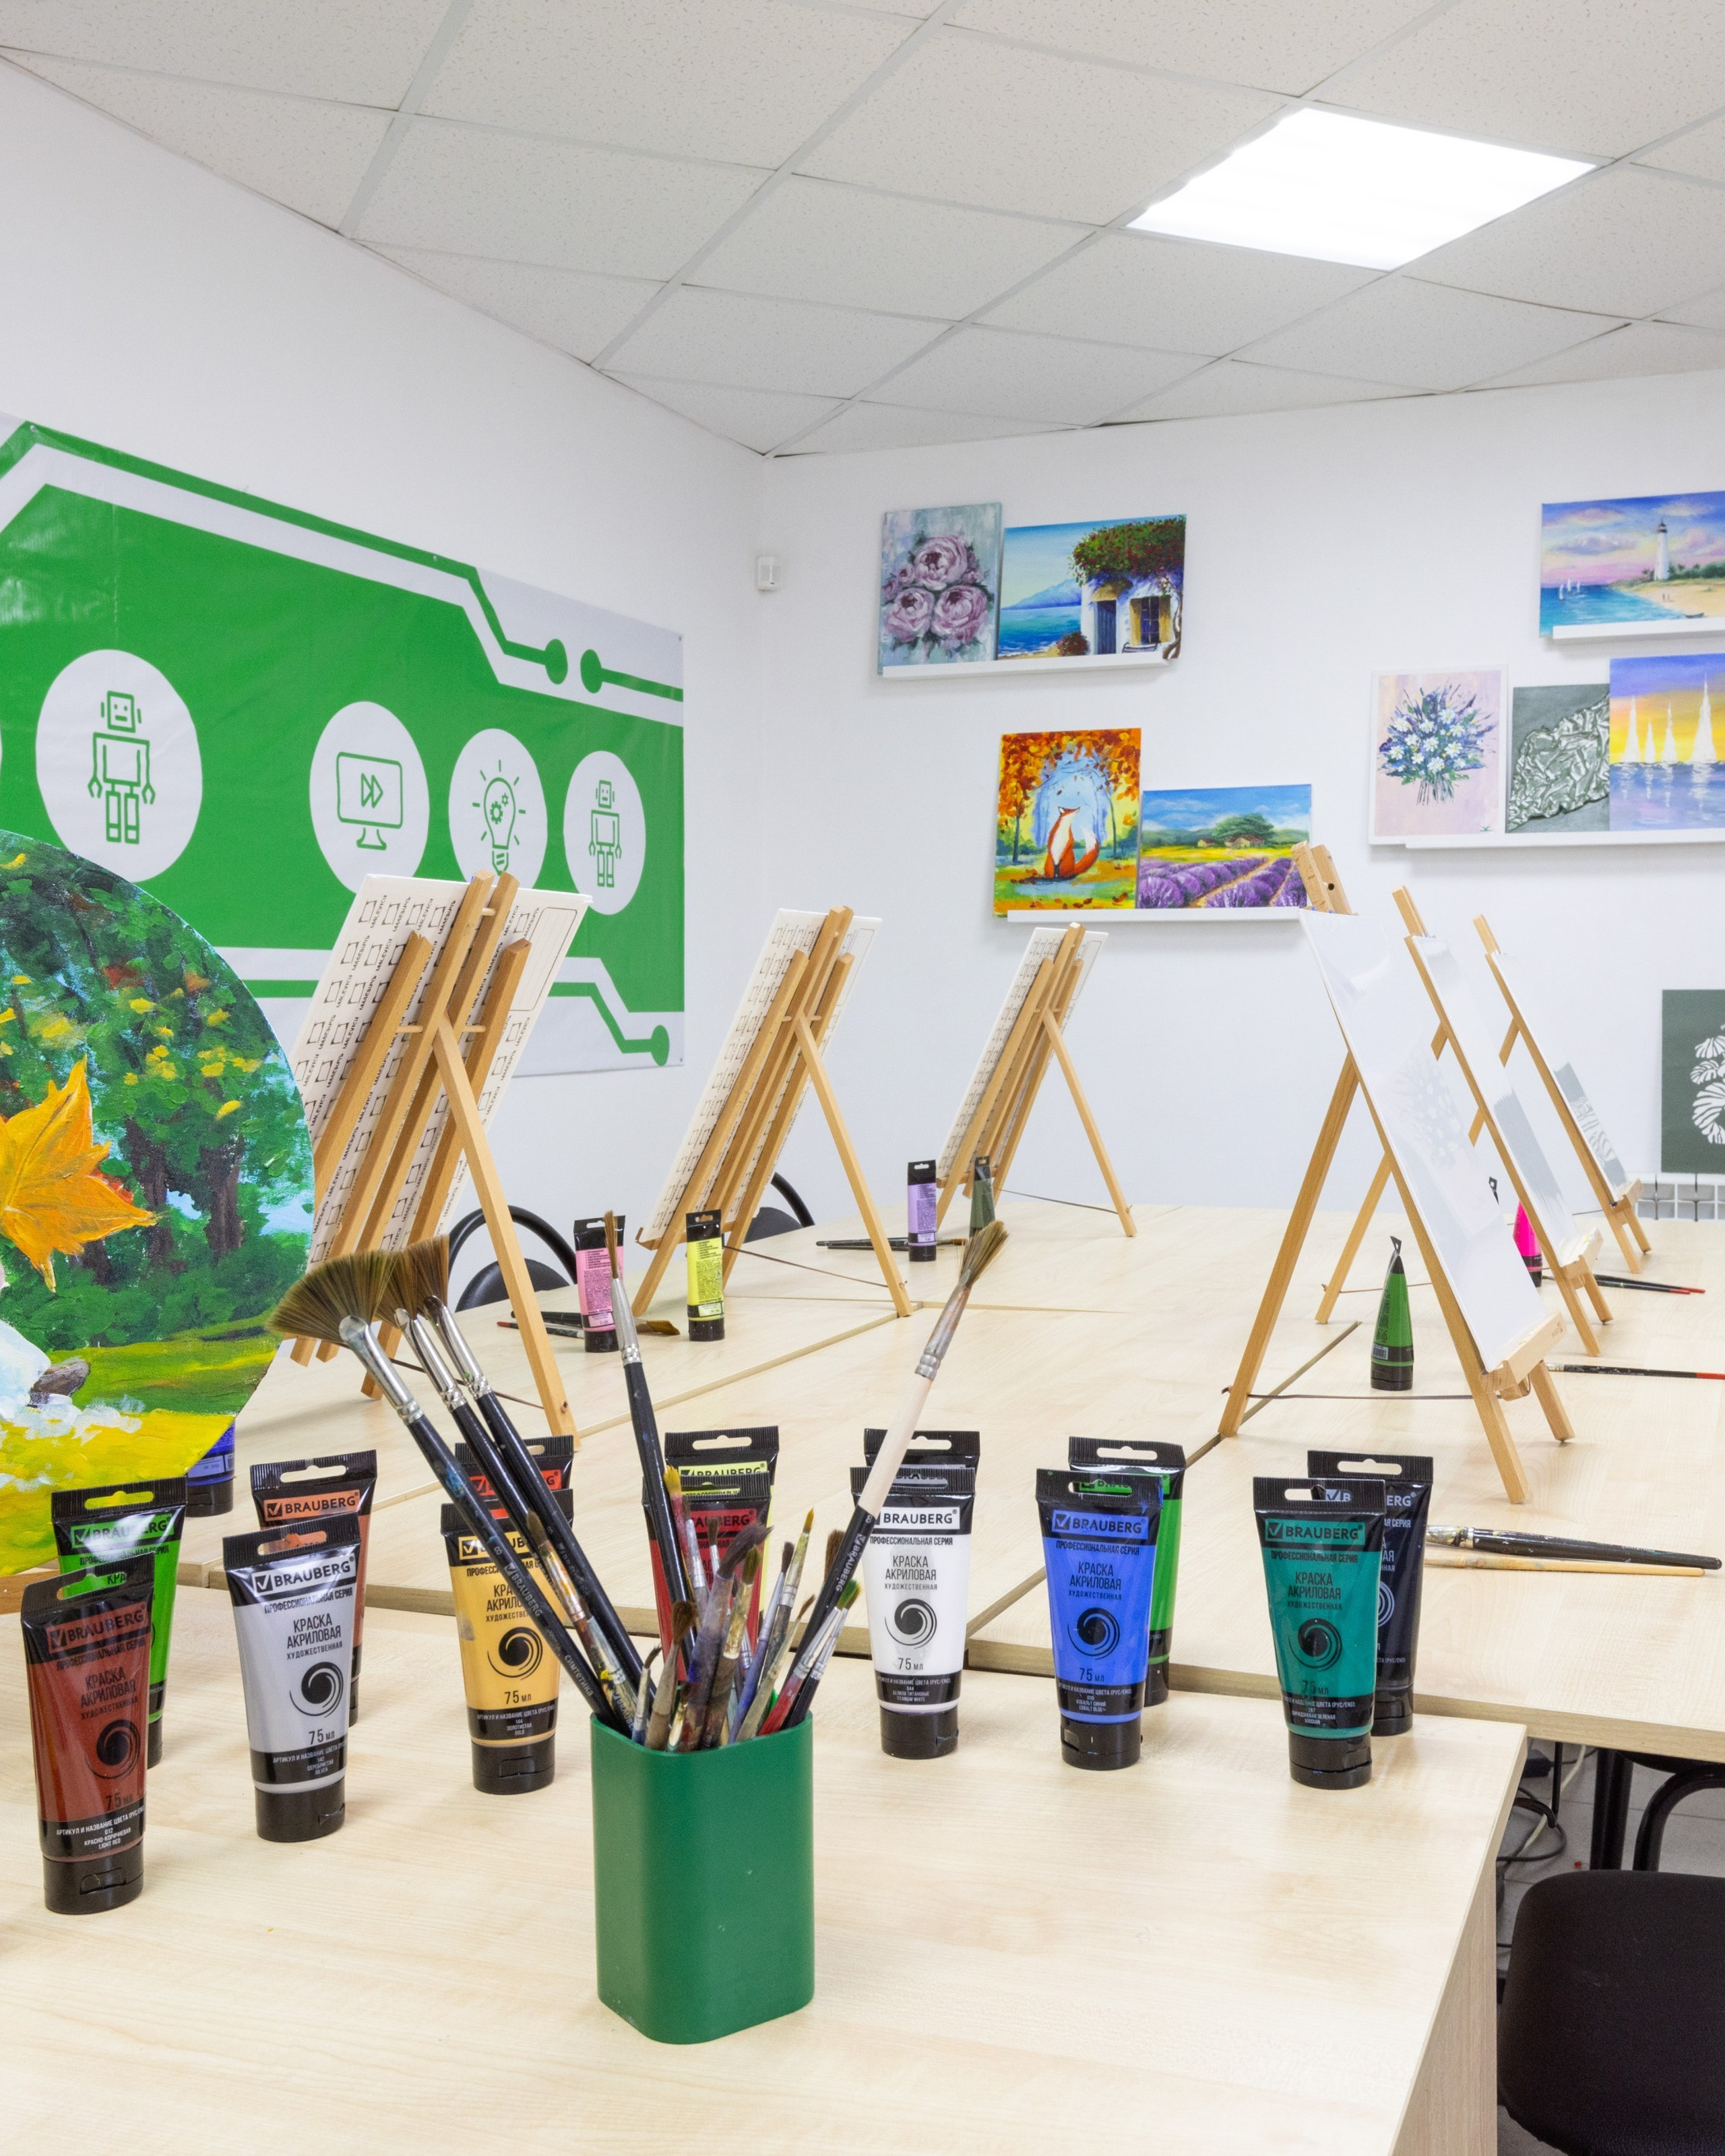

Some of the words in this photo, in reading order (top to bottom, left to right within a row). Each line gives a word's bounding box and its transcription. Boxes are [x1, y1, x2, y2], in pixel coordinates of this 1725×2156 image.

[370, 895, 387, 928] MALEVICH
[503, 906, 519, 936] MALEVICH
[376, 939, 393, 971] MALEVICH
[336, 975, 352, 1008] MALEVICH
[342, 1017, 359, 1049] MALEVICH
[515, 1017, 530, 1046] MALEVICH
[311, 1094, 327, 1126] MALEVICH
[285, 1496, 355, 1514] BRAUBERG
[866, 1515, 873, 1523] 8
[883, 1513, 953, 1524] BRAUBERG
[1073, 1518, 1142, 1533] BRAUBERG
[1286, 1525, 1359, 1540] BRAUBERG
[870, 1536, 933, 1546] ПРОФЕССИОНАЛЬНАЯ
[933, 1537, 953, 1546] СЕРИЯ
[1056, 1540, 1119, 1554] ПРОФЕССИОНАЛЬНАЯ
[1120, 1546, 1139, 1556] СЕРИЯ
[494, 1546, 503, 1556] 8
[1271, 1551, 1338, 1562] ПРОФЕССИОНАЛЬНАЯ
[1338, 1554, 1358, 1563] СЕРИЯ
[836, 1544, 861, 1591] BRAUBERG
[893, 1556, 929, 1568] КРАСКА
[1078, 1562, 1114, 1577] КРАСКА
[274, 1560, 350, 1587] BRAUBERG
[885, 1568, 937, 1581] АКРИЛОВАЯ
[1295, 1571, 1333, 1586] КРАСКА
[884, 1583, 938, 1591] ХУДОЖЕСТВЕННАЯ
[1069, 1575, 1121, 1591] АКРИЛОВАЯ
[264, 1592, 334, 1614] ПРОФЕССИОНАЛЬНАЯ
[335, 1587, 353, 1599] СЕРИЯ
[511, 1571, 544, 1617] BRAUBERG
[1068, 1589, 1122, 1601] ХУДОЖЕСТВЕННАЯ
[1288, 1585, 1341, 1600] АКРИЛОВАЯ
[1287, 1601, 1342, 1610] ХУДОЖЕСТВЕННАЯ
[68, 1610, 144, 1642] BRAUBERG
[293, 1613, 332, 1633] КРАСКА
[287, 1625, 341, 1649] АКРИЛОВАЯ
[287, 1641, 342, 1660] ХУДОЖЕСТВЕННАЯ
[898, 1657, 912, 1670] 75
[86, 1667, 126, 1690] КРАСКА
[1079, 1668, 1093, 1682] 75
[81, 1680, 136, 1707] АКРИЛОВАЯ
[505, 1690, 520, 1704] 75
[522, 1694, 532, 1702] мл
[82, 1697, 137, 1719] ХУДОЖЕСТВЕННАЯ
[500, 1711, 523, 1719] НАЗВАНИЕ
[309, 1729, 323, 1745] 75
[325, 1731, 335, 1740] мл
[273, 1756, 296, 1764] АРТИКУЛ
[301, 1750, 324, 1760] НАЗВАНИЕ
[105, 1792, 121, 1810] 75
[57, 1827, 80, 1835] АРТИКУЛ
[86, 1820, 113, 1832] НАЗВАНИЕ
[114, 1814, 129, 1825] ЦВЕТА
[84, 1827, 131, 1846] КРАСНО-КОРИЧНЕВАЯ
[99, 1841, 111, 1849] LIGHT
[113, 1838, 121, 1847] RED
